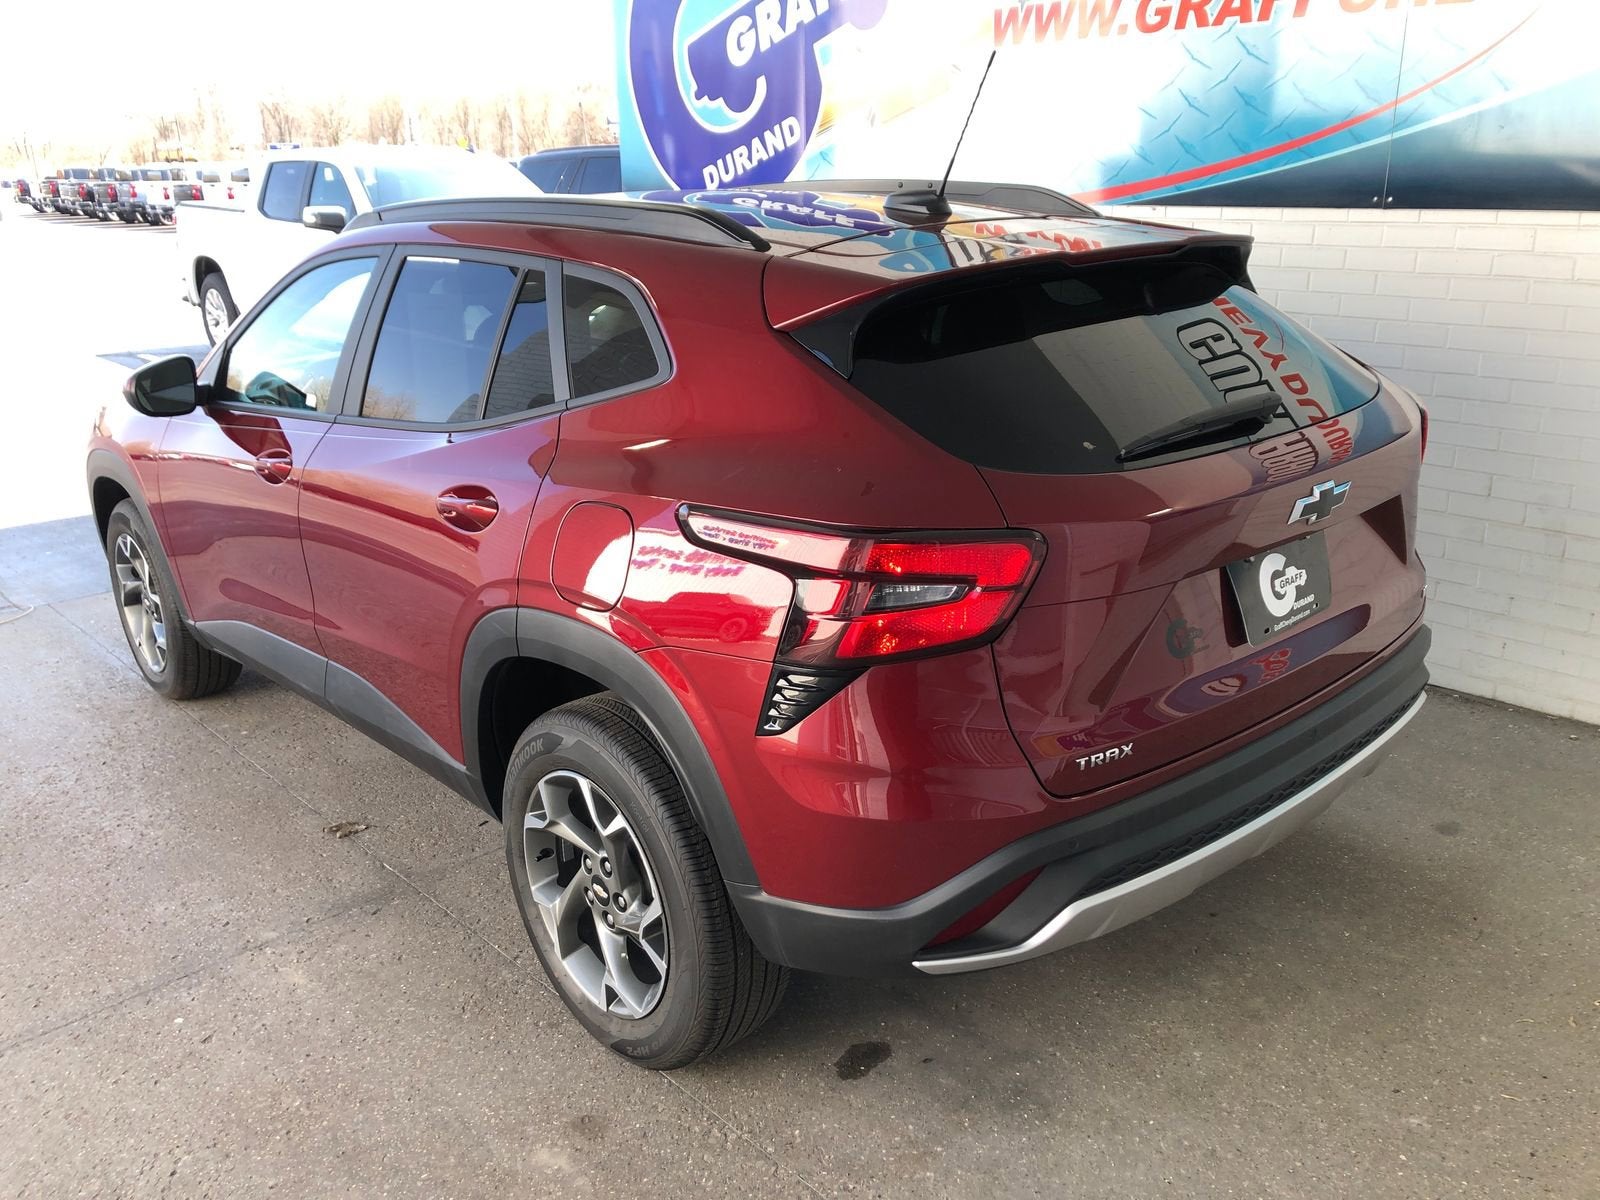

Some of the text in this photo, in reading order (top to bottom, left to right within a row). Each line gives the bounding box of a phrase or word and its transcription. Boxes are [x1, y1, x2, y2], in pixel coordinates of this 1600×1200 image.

[703, 116, 801, 190] DURAND
[1279, 571, 1304, 589] GRAFF
[1293, 594, 1315, 610] DURAND
[1075, 743, 1133, 770] TRAX
